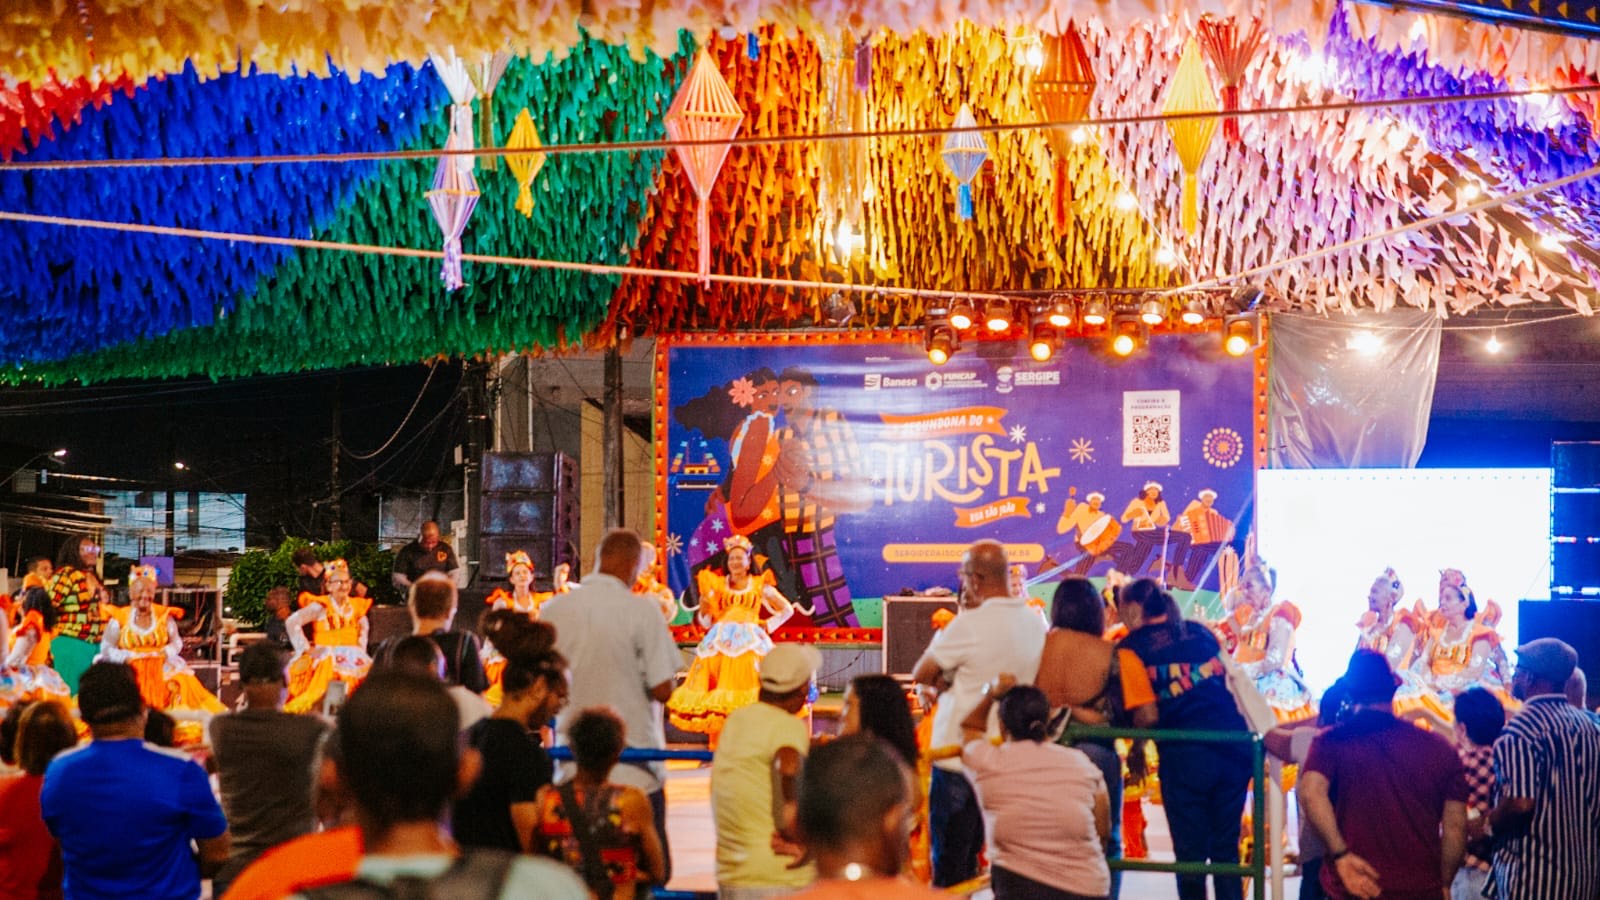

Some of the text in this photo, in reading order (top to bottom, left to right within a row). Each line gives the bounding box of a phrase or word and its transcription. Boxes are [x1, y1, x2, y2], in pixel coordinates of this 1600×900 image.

[882, 377, 918, 387] Banese
[1014, 371, 1061, 381] SERGIPE
[969, 414, 983, 427] DO
[870, 434, 1061, 506] TURISTA
[969, 511, 984, 523] RUA
[984, 505, 998, 519] SÃO
